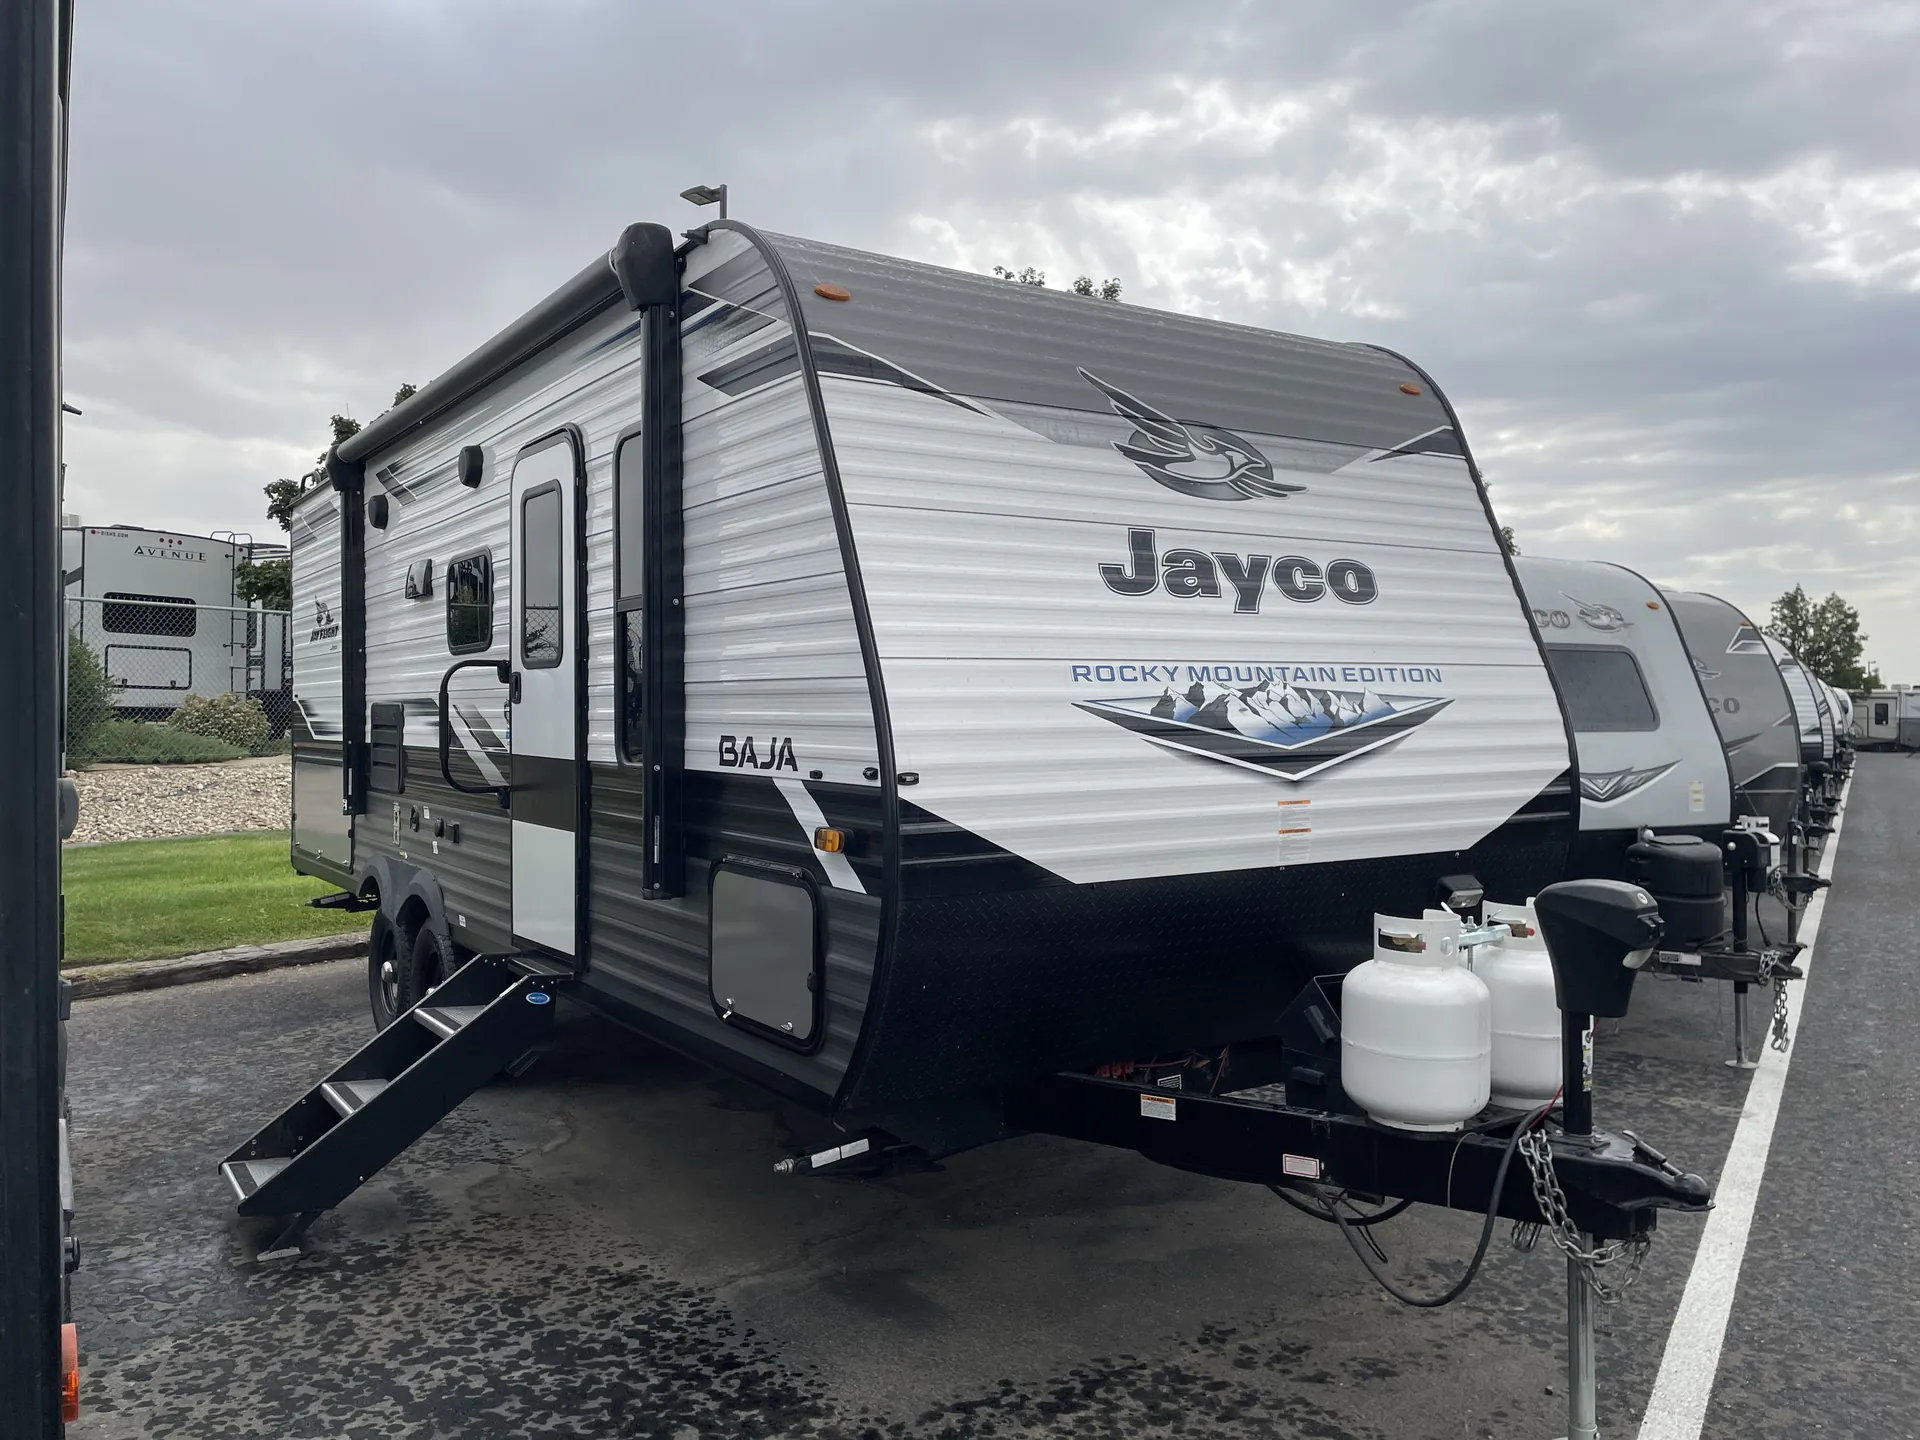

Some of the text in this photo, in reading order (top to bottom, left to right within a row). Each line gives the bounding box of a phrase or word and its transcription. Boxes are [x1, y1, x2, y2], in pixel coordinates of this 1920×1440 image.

[134, 545, 206, 561] AVENUE
[1098, 527, 1379, 614] Jayco
[1071, 665, 1443, 683] ROCKY MOUNTAIN EDITION
[719, 735, 799, 772] BAJA
